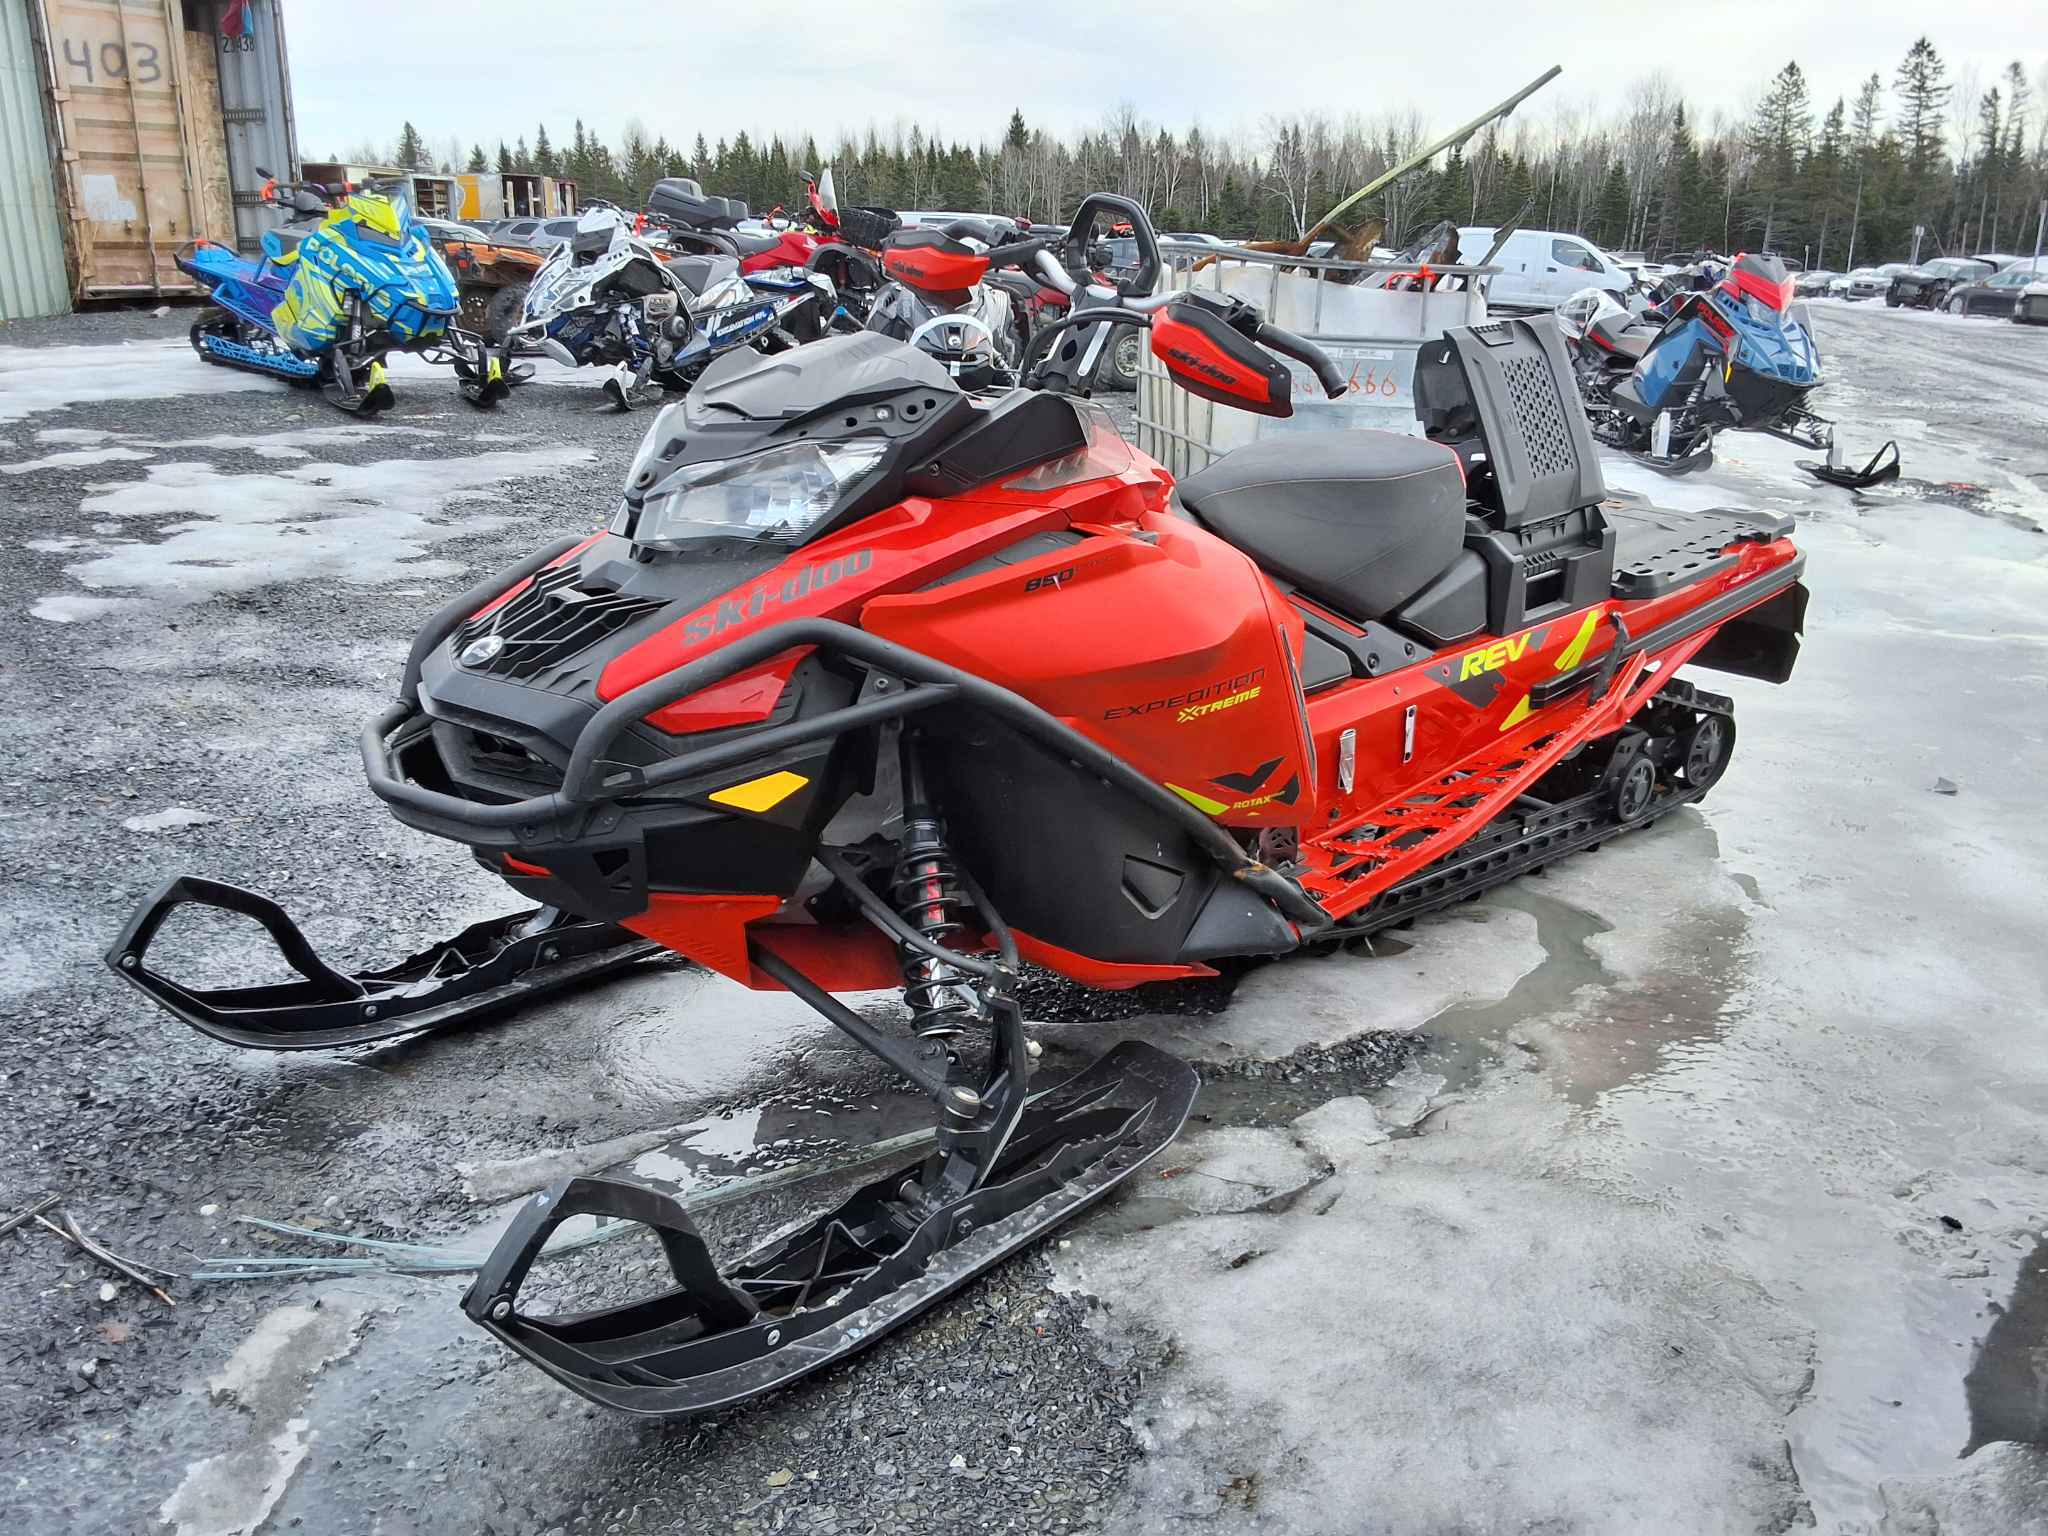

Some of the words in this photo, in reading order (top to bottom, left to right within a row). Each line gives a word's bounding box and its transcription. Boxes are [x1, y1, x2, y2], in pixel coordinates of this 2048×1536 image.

[63, 38, 161, 83] 403
[1025, 567, 1073, 593] 850
[1459, 631, 1532, 682] REV
[1103, 667, 1265, 720] EXPEDITION
[1177, 686, 1261, 723] XTREME
[1233, 795, 1271, 809] ROTAX
